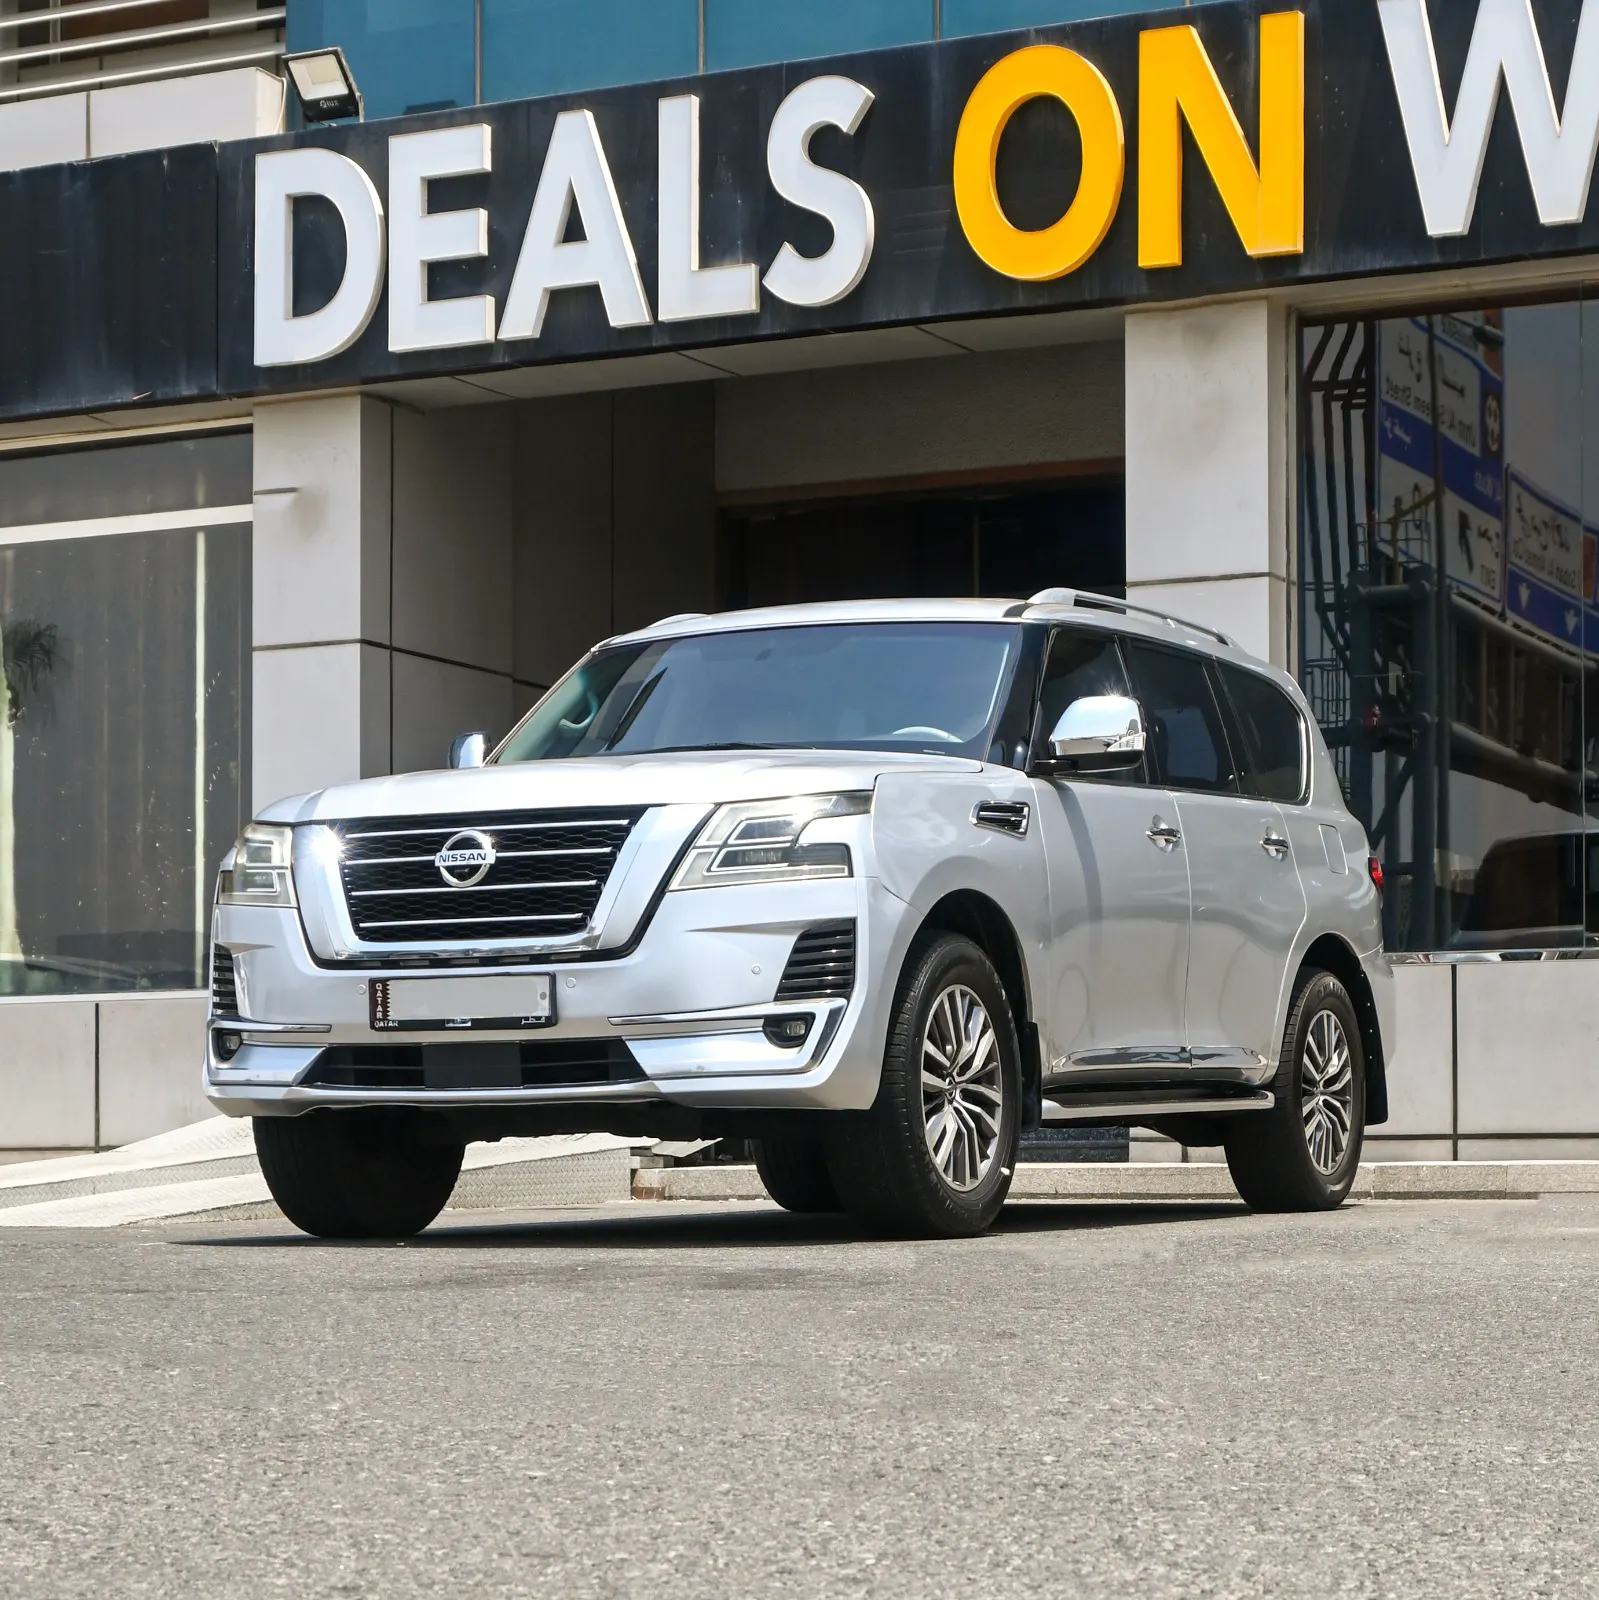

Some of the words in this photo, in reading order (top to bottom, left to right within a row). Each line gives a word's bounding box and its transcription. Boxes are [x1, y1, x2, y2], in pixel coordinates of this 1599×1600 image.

[254, 75, 875, 367] DEALS
[953, 10, 1305, 282] ON
[1377, 0, 1599, 238] W
[438, 852, 487, 863] NISSAN
[375, 982, 383, 1019] QATAR
[374, 1020, 399, 1028] QATAR
